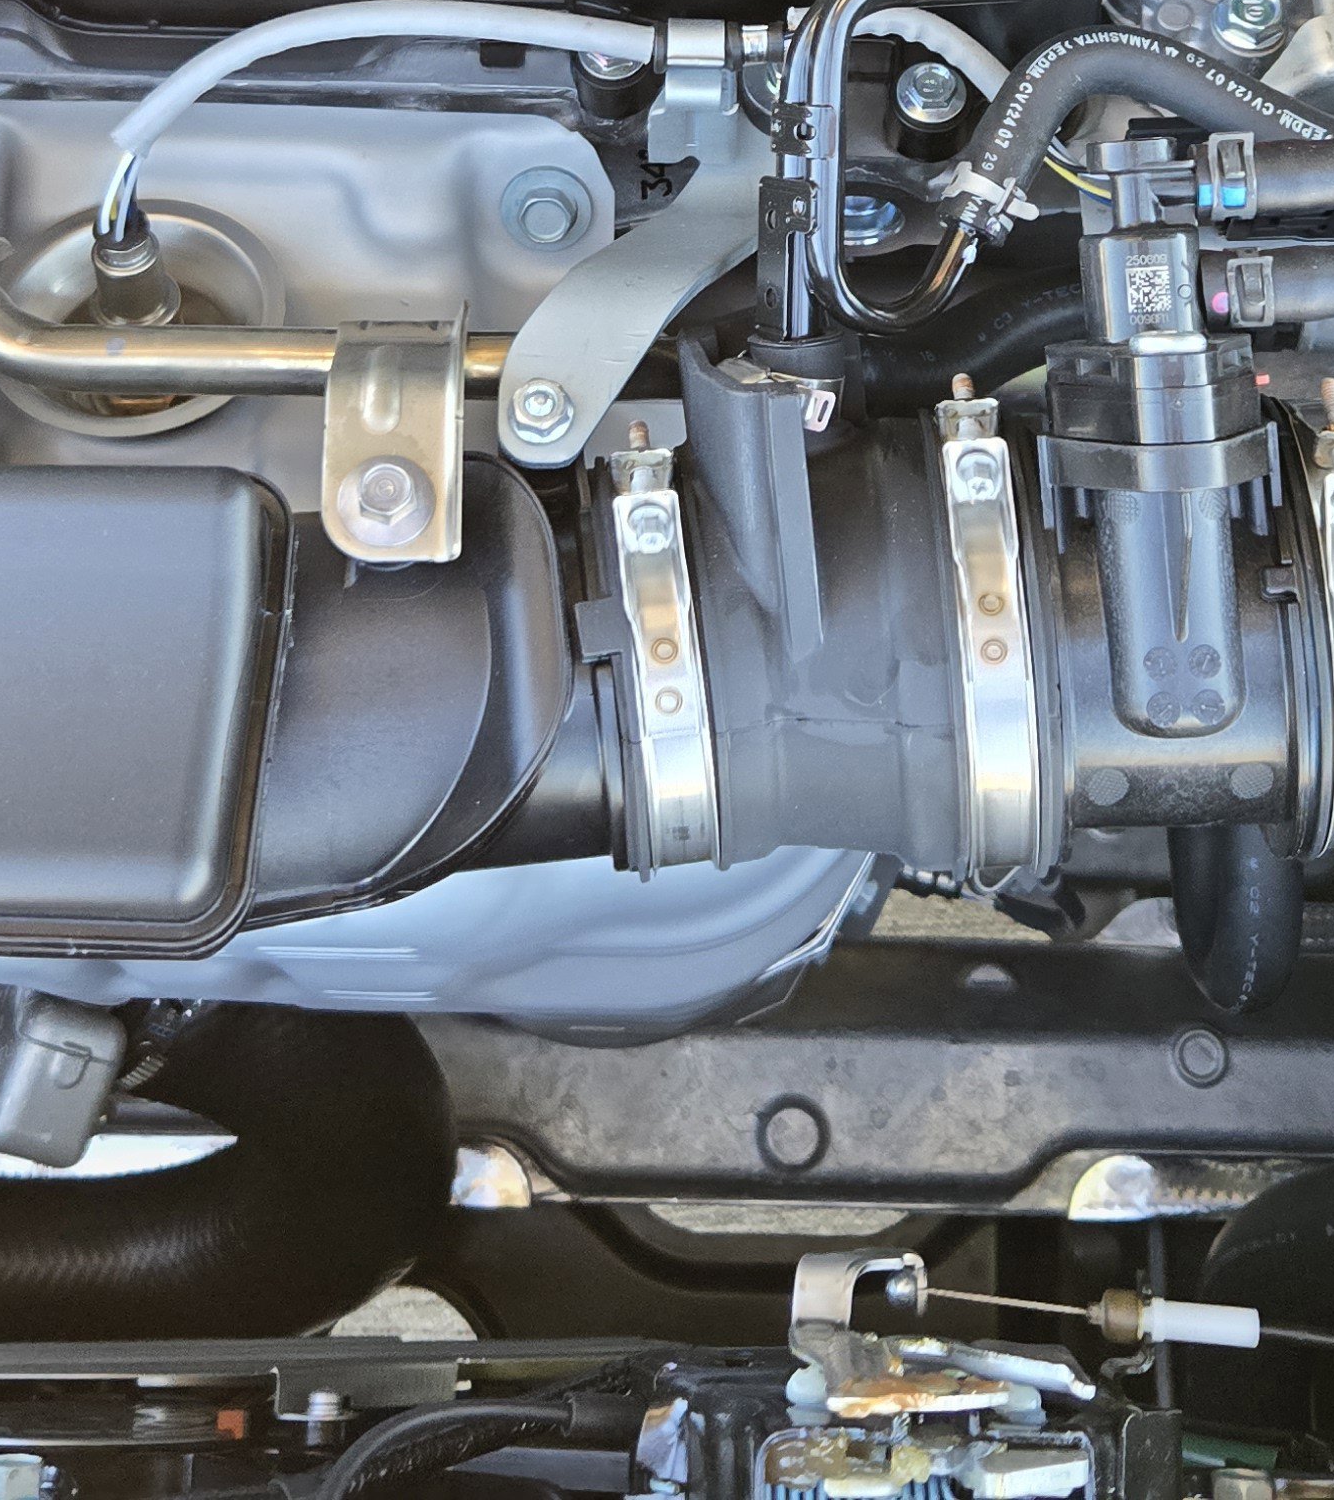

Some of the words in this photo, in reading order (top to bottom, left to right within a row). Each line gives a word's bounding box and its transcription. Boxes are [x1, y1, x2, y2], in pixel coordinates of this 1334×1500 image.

[1073, 31, 1162, 55] YAMASHITA
[1186, 54, 1206, 68] 29
[982, 151, 999, 172] 29
